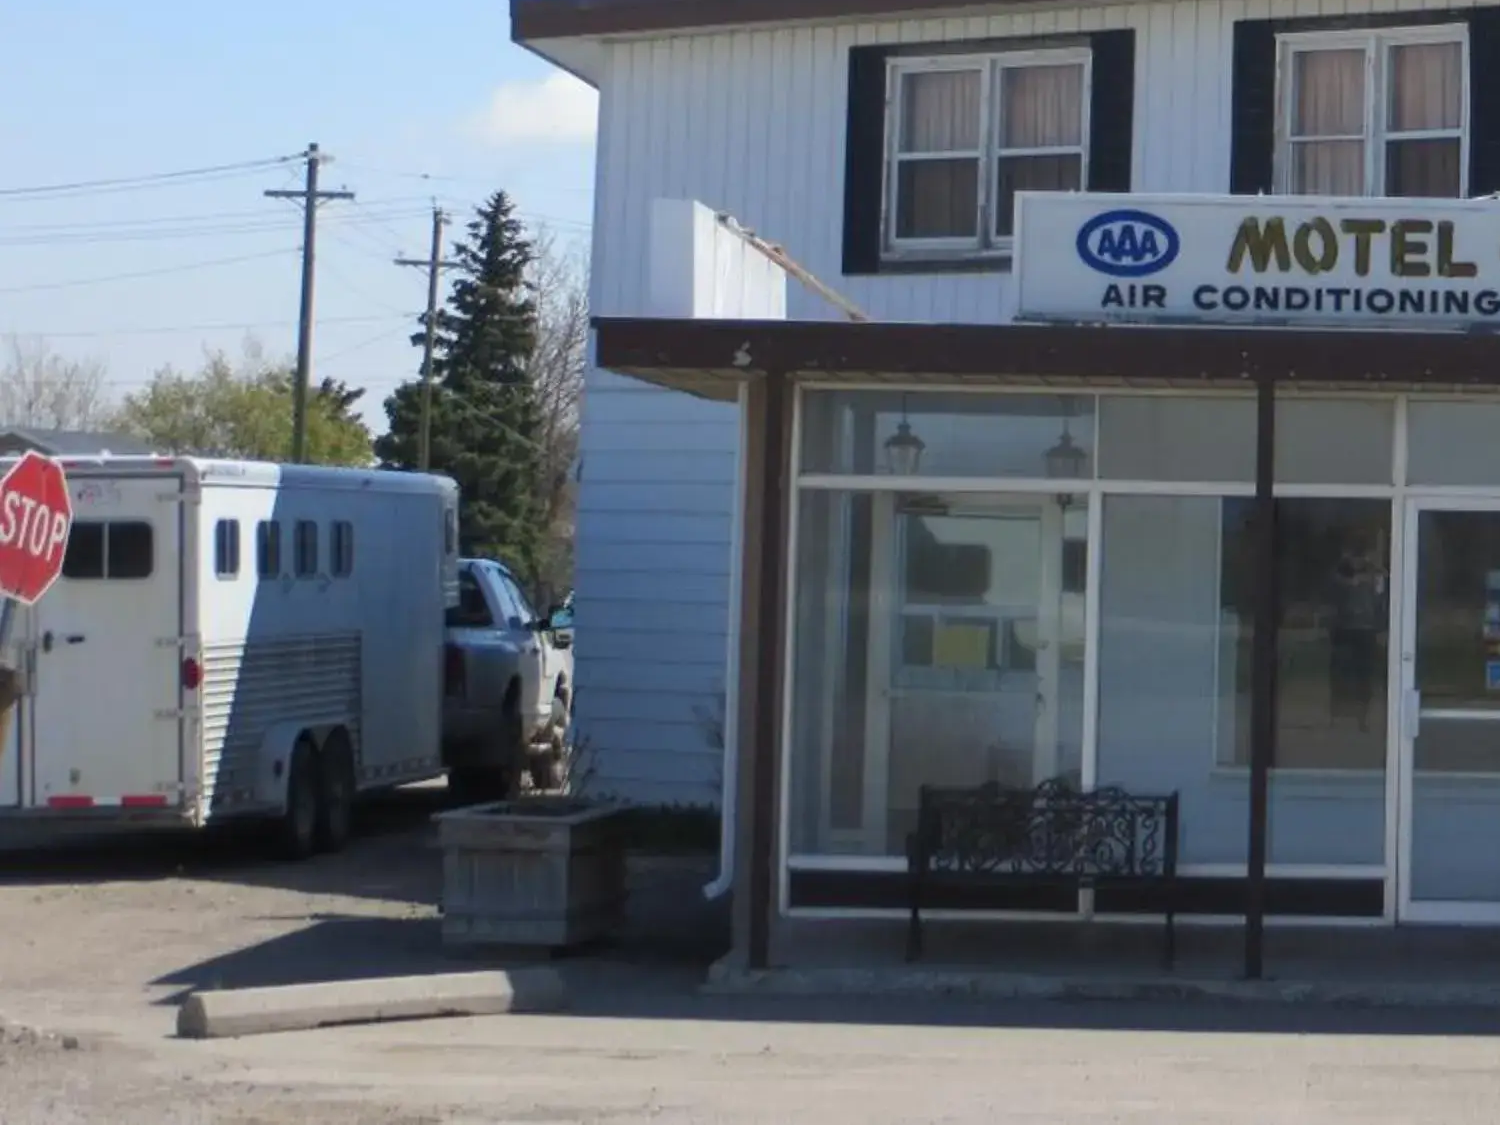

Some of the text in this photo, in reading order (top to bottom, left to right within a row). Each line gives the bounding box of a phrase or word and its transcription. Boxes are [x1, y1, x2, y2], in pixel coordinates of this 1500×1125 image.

[1097, 223, 1159, 262] AAA
[1226, 215, 1478, 278] MOTEL
[1101, 283, 1168, 309] AIR
[0, 490, 67, 562] STOP
